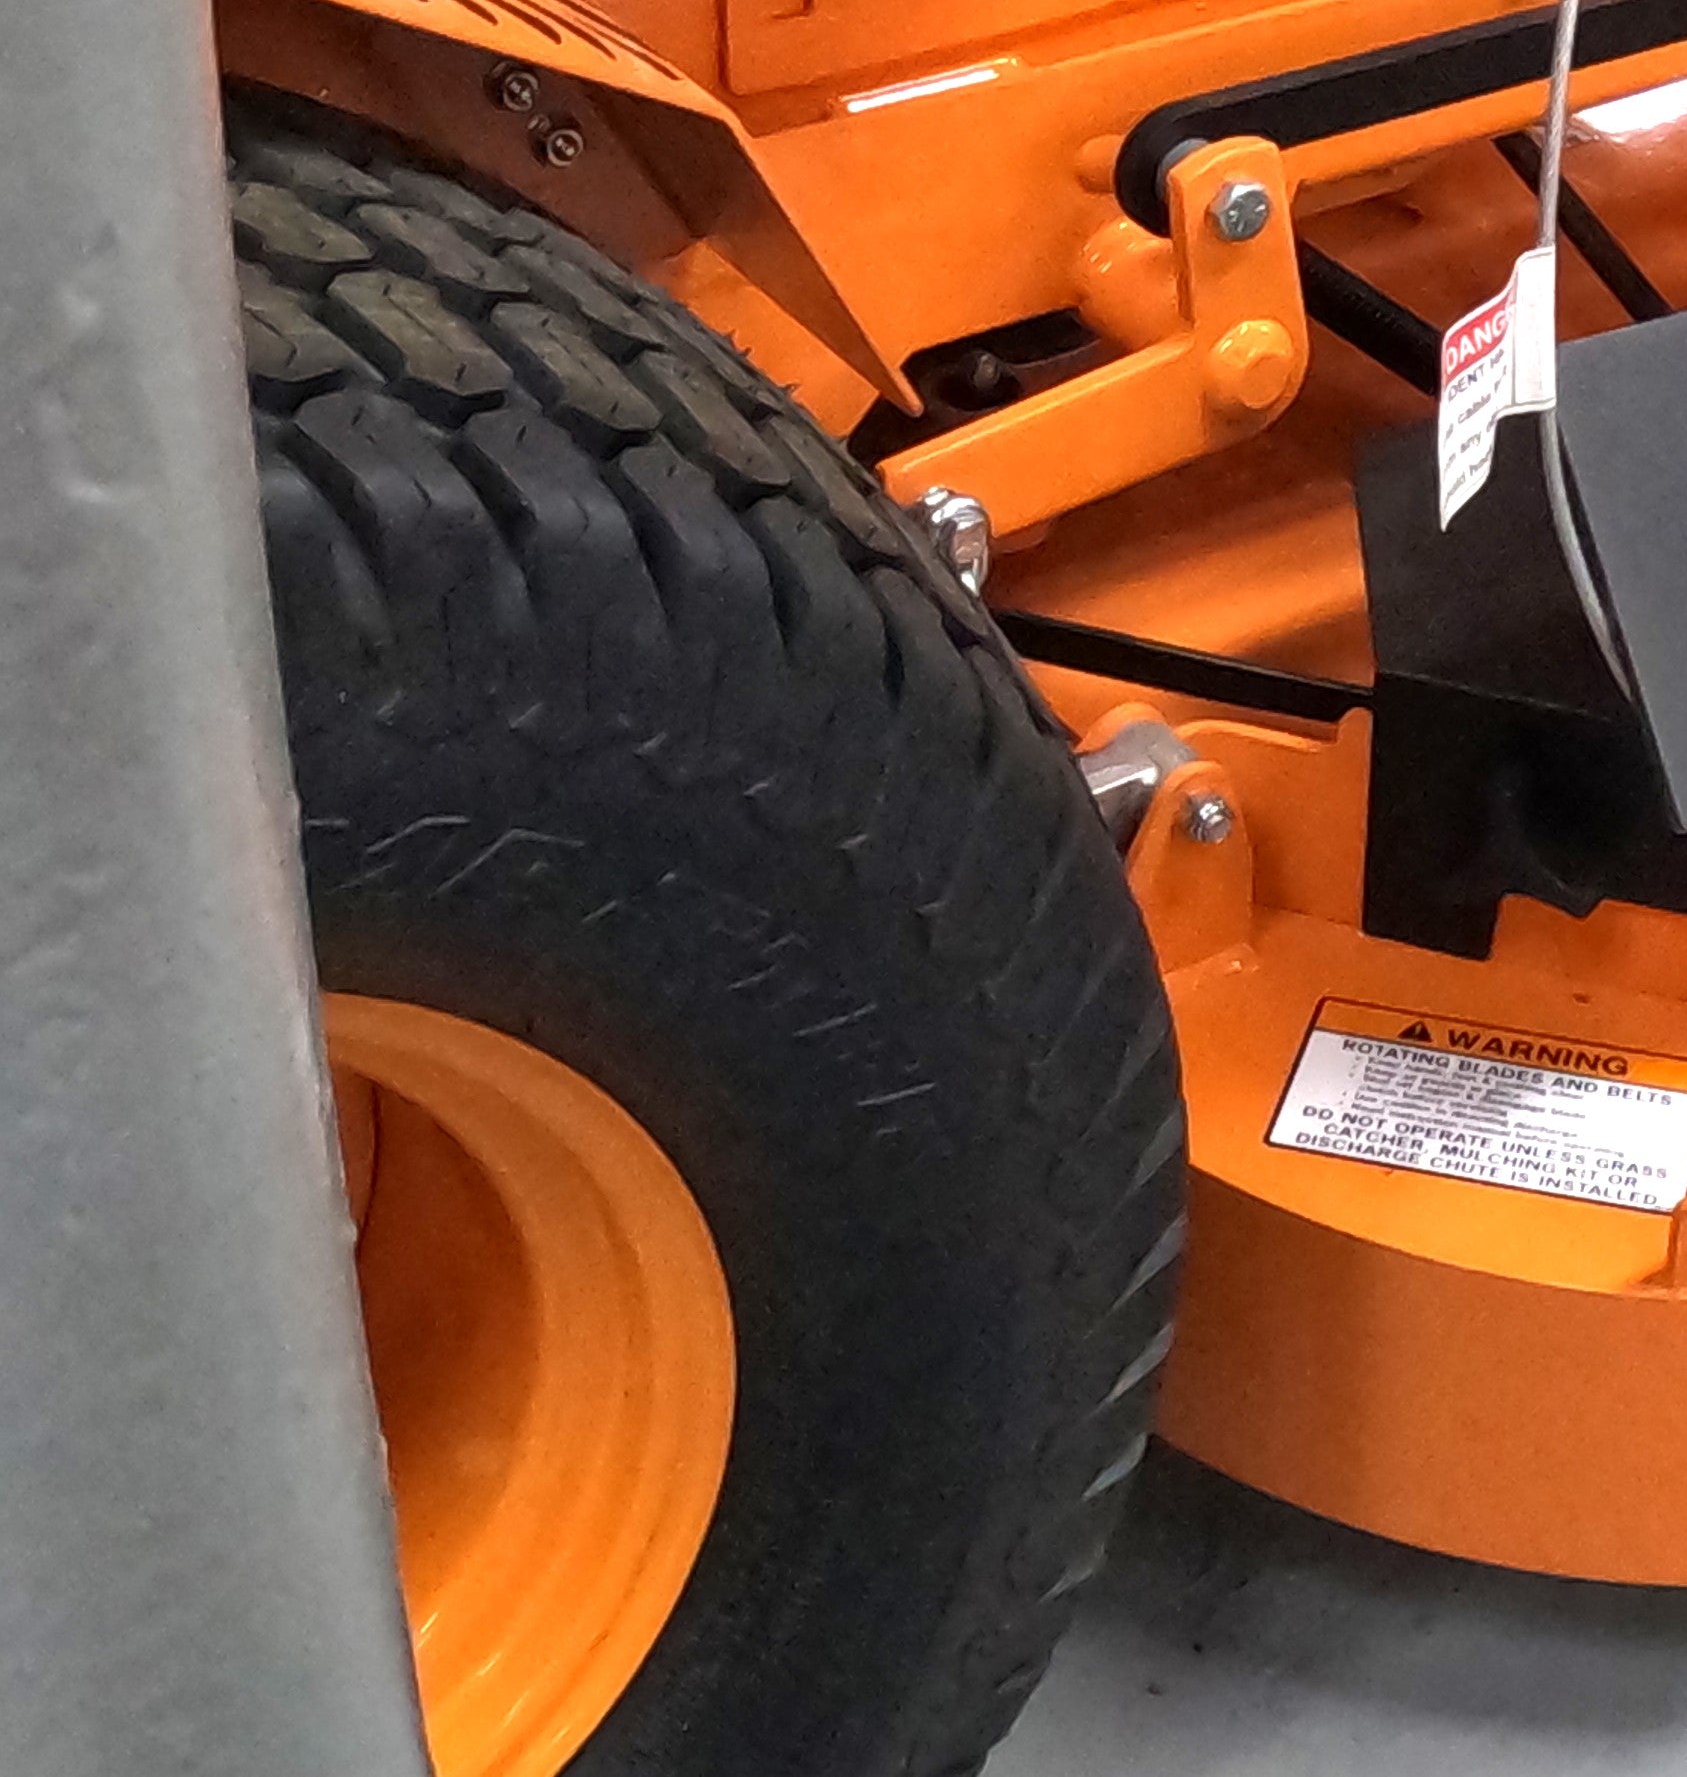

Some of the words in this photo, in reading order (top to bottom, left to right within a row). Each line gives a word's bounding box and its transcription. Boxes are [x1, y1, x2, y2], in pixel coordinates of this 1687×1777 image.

[1341, 1038, 1451, 1069] ROTATING
[1457, 1059, 1545, 1084] BLADES
[1550, 1075, 1600, 1094] AND
[1606, 1084, 1674, 1106] BELTS
[1447, 1027, 1630, 1077] WARNING
[1295, 1131, 1421, 1165] DISCHARGE
[1429, 1155, 1500, 1179] CHUTE
[1510, 1170, 1530, 1184] IS
[1538, 1174, 1658, 1206] INSTALLED
[1302, 1104, 1335, 1121] DO
[1341, 1111, 1388, 1131] NOT
[1394, 1121, 1493, 1150] OPERATE
[1501, 1140, 1586, 1166] UNLESS
[1595, 1157, 1668, 1179] GRASS
[1438, 1143, 1557, 1174] MULCHING
[1565, 1165, 1600, 1181] KIT
[1607, 1173, 1638, 1188] OR
